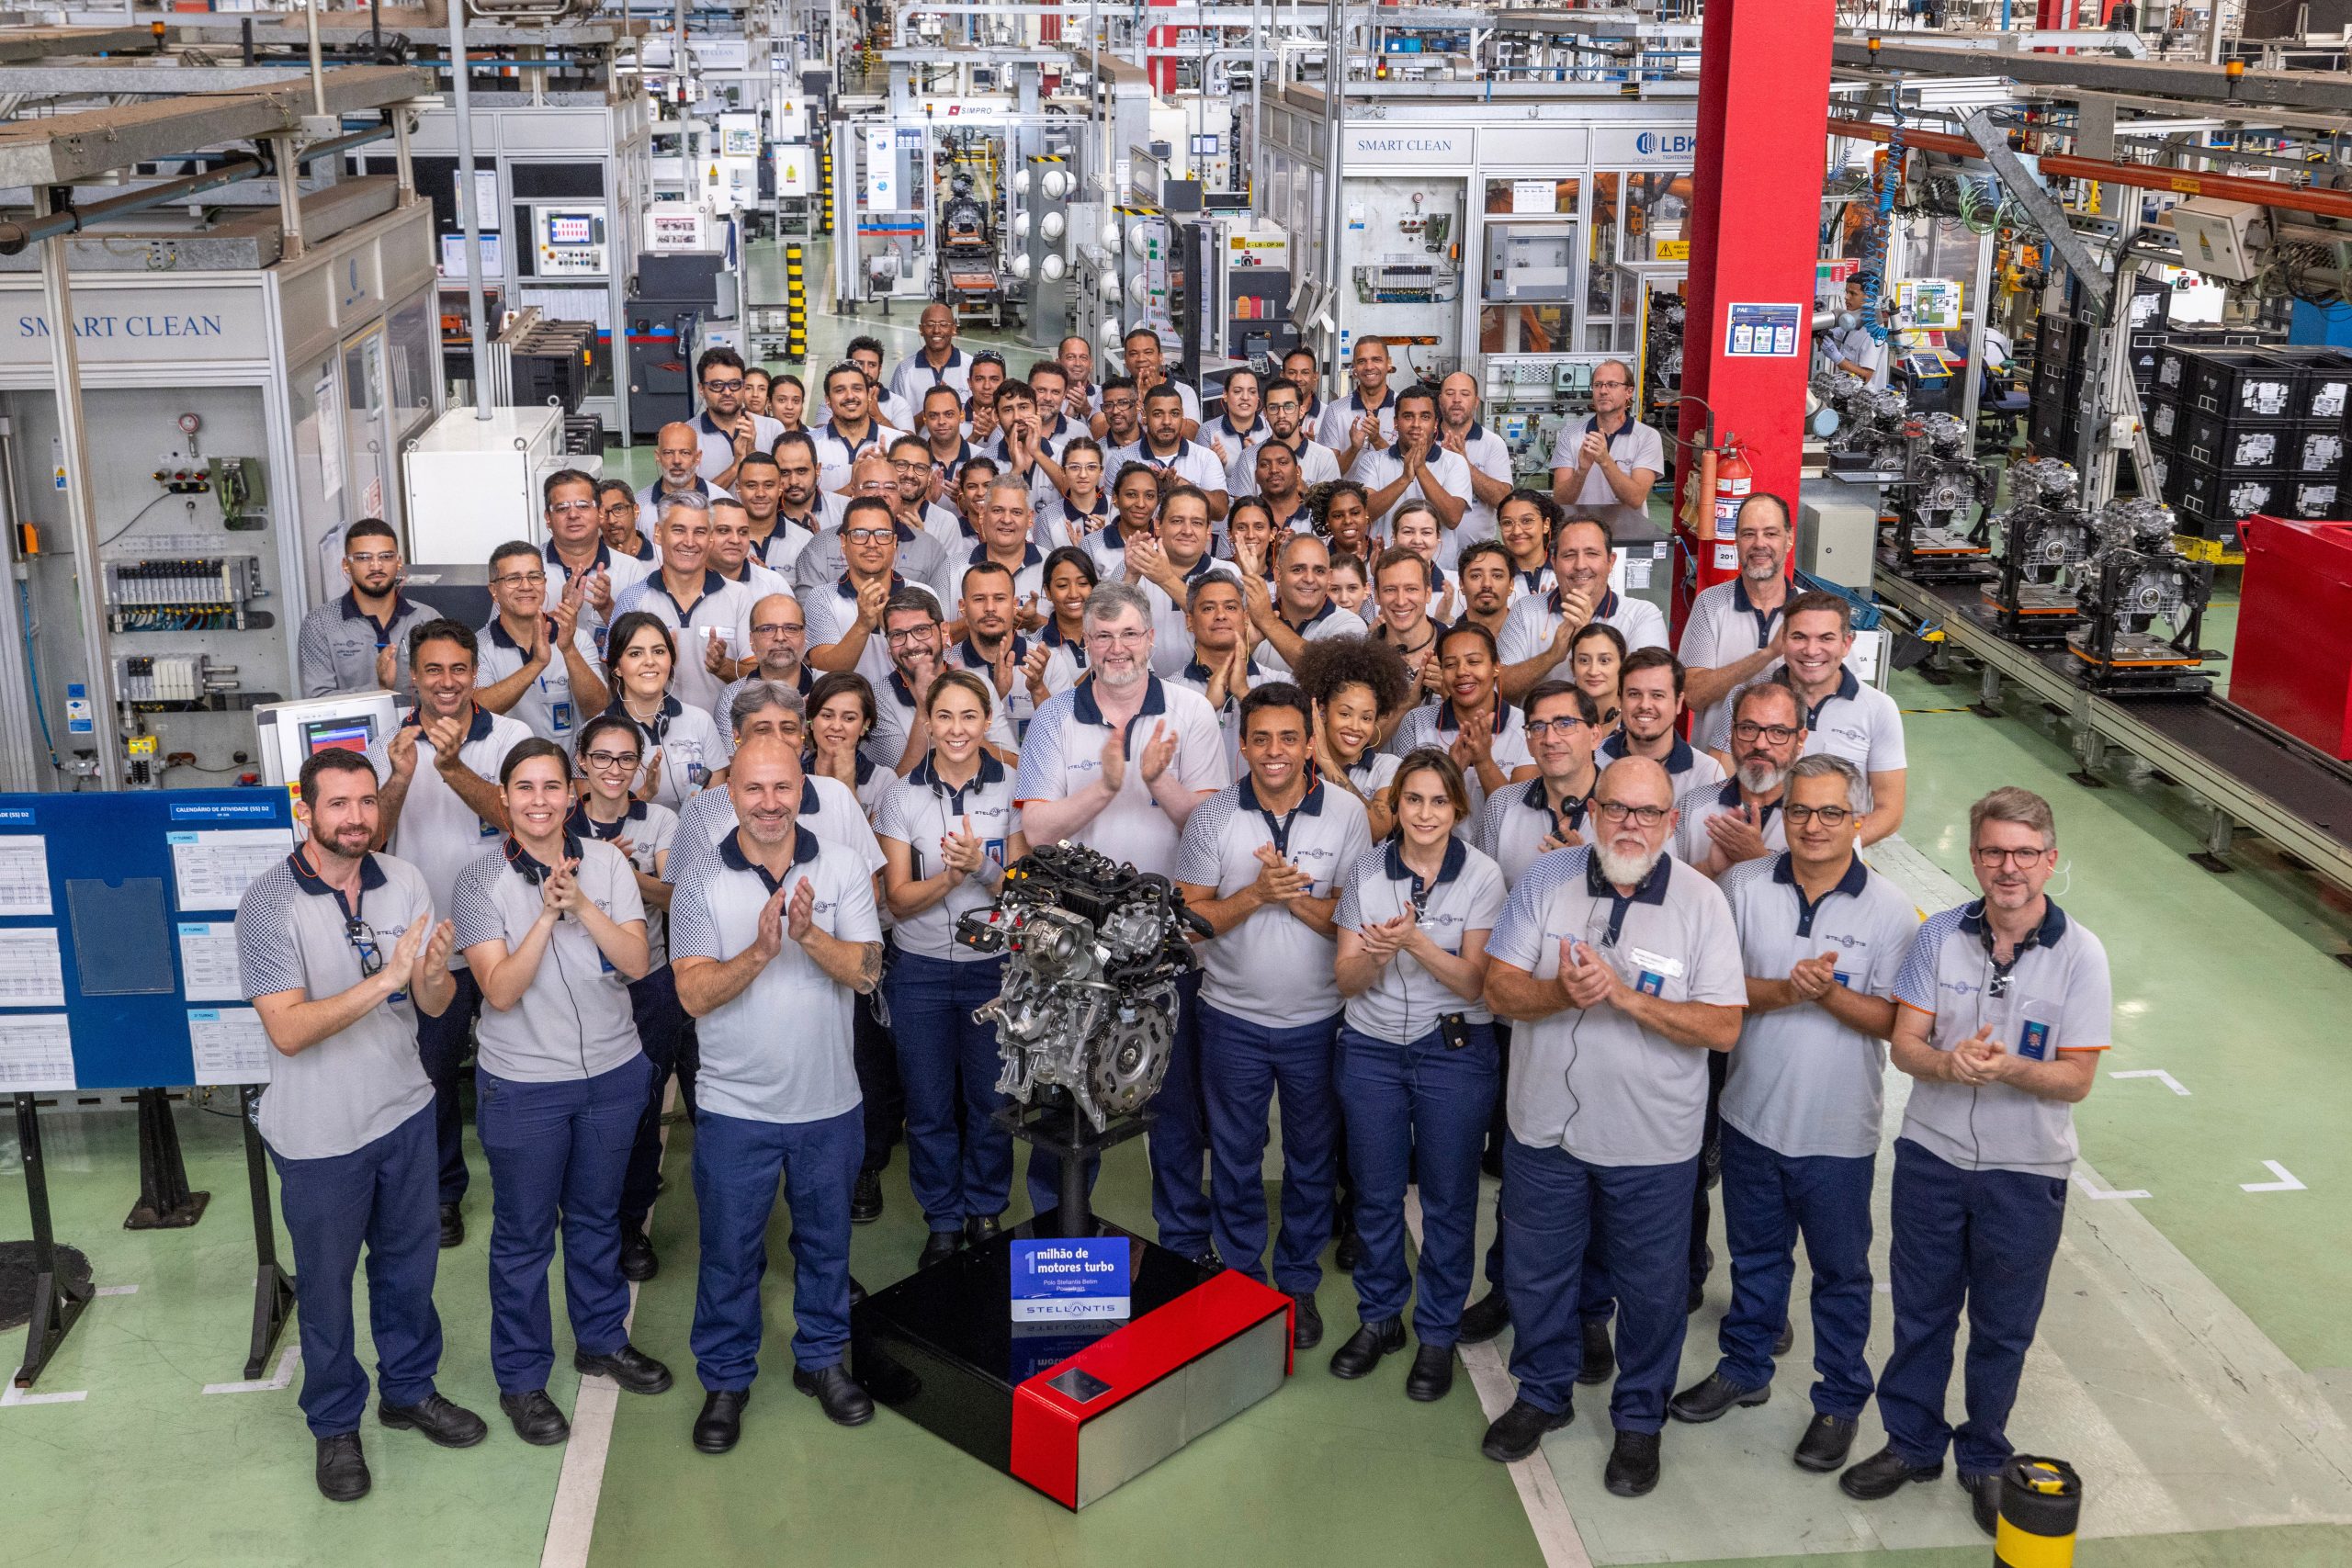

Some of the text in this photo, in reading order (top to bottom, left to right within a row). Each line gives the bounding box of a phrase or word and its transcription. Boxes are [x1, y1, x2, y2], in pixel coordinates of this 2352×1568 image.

[961, 107, 992, 115] SIMPRO
[1358, 140, 1452, 152] SMART CLEAN
[125, 315, 222, 337] CLEAN
[1297, 850, 1333, 858] STELLANTIS
[1826, 935, 1866, 947] STELLANTIS
[1024, 1248, 1089, 1274] 1 milhão de
[1037, 1261, 1114, 1273] motores turbo
[1026, 1303, 1115, 1314] STELLANTIS
